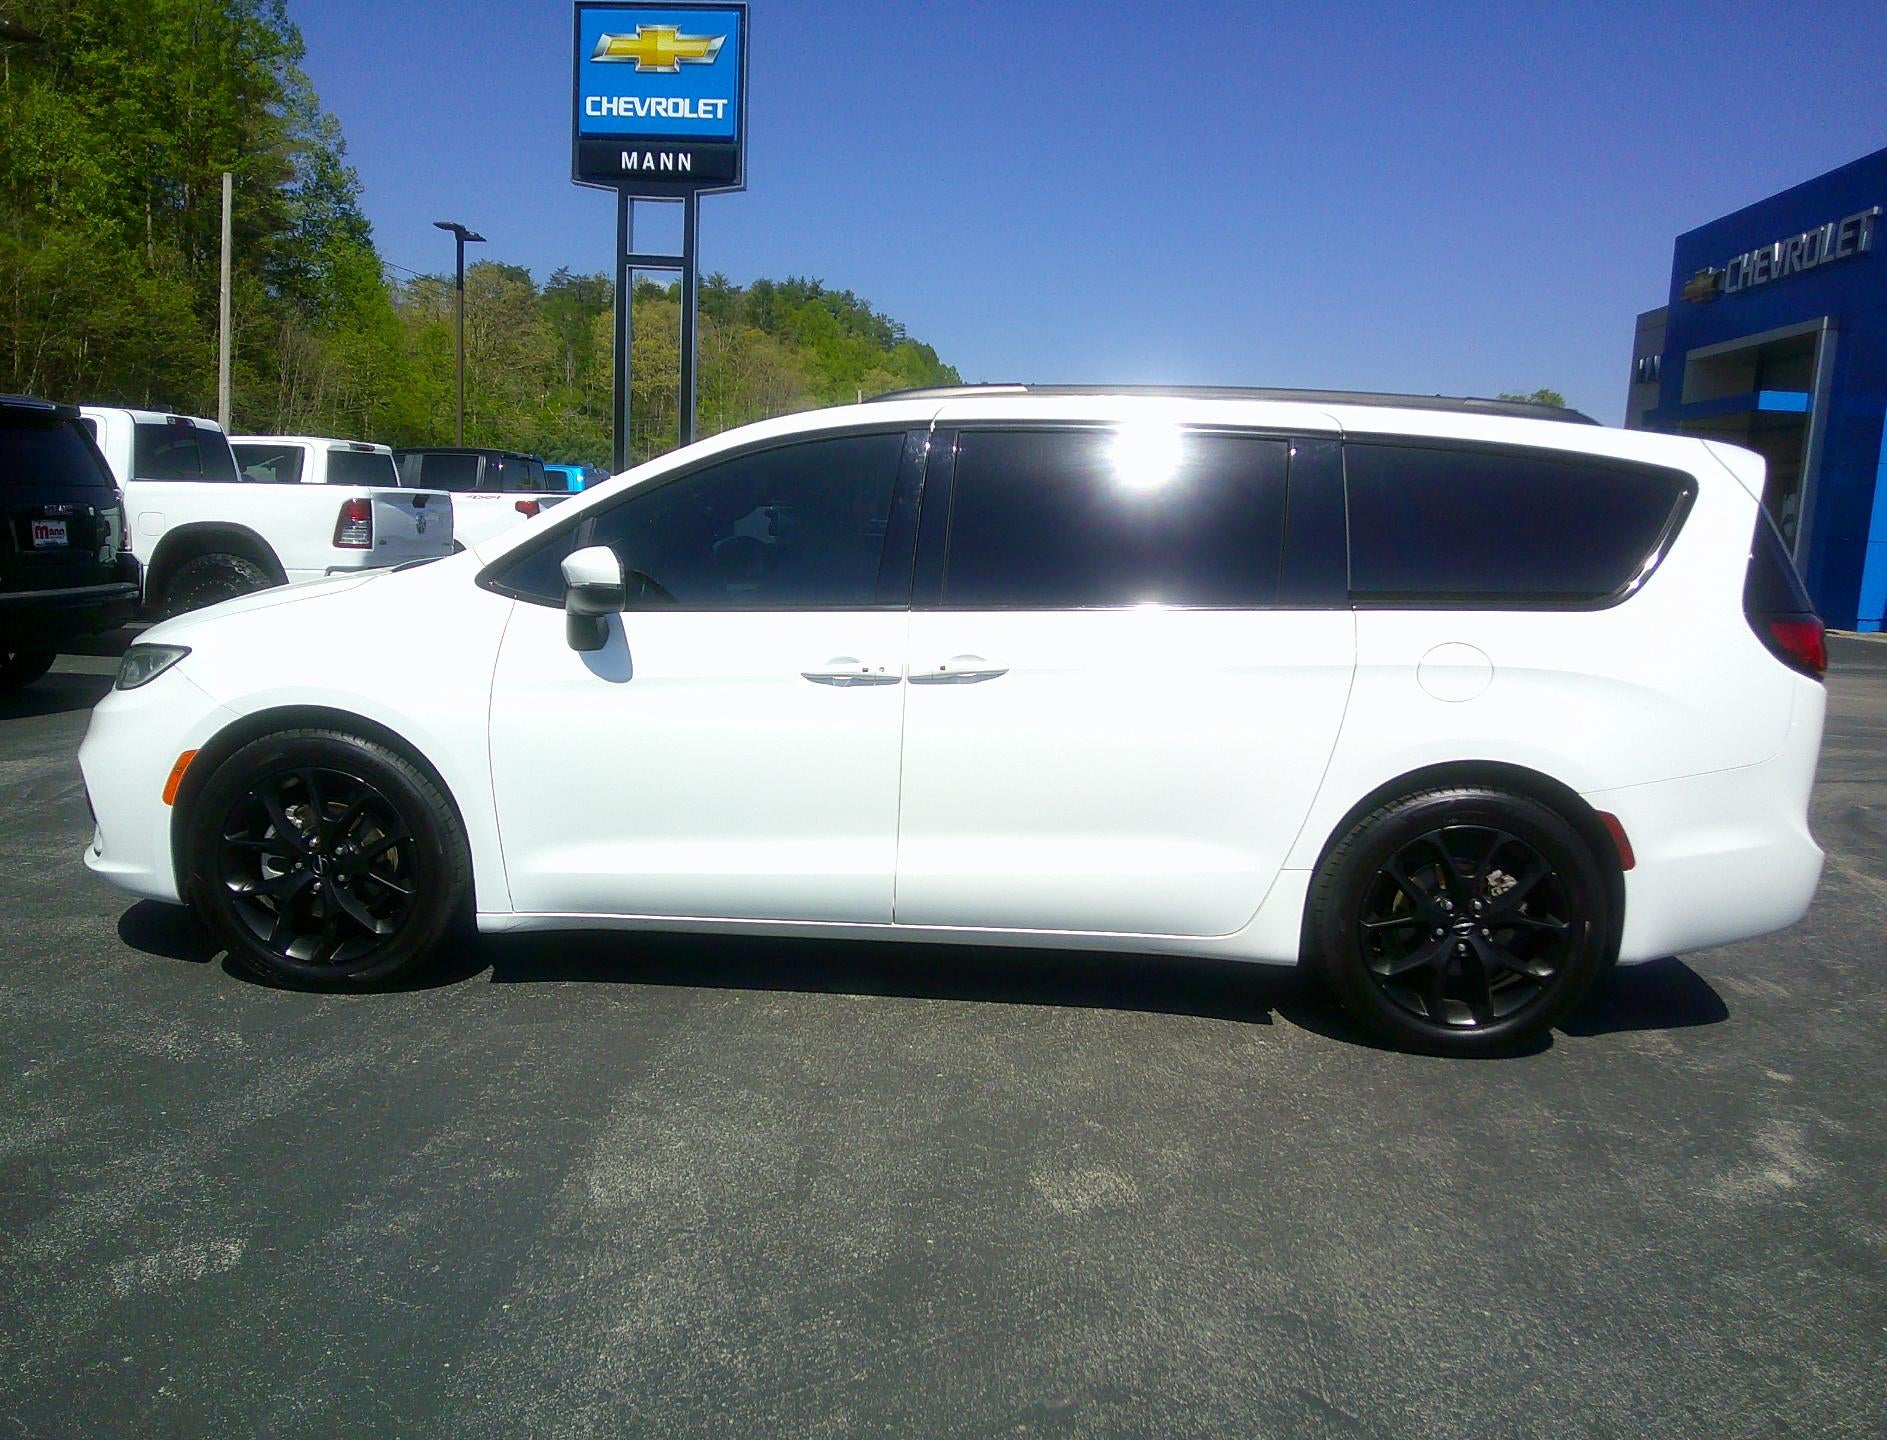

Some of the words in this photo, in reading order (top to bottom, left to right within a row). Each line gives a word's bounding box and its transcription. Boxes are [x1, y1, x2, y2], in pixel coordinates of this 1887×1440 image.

[585, 96, 728, 120] CHEVROLET
[621, 151, 692, 172] MANN
[1725, 206, 1883, 293] CHEVROLET
